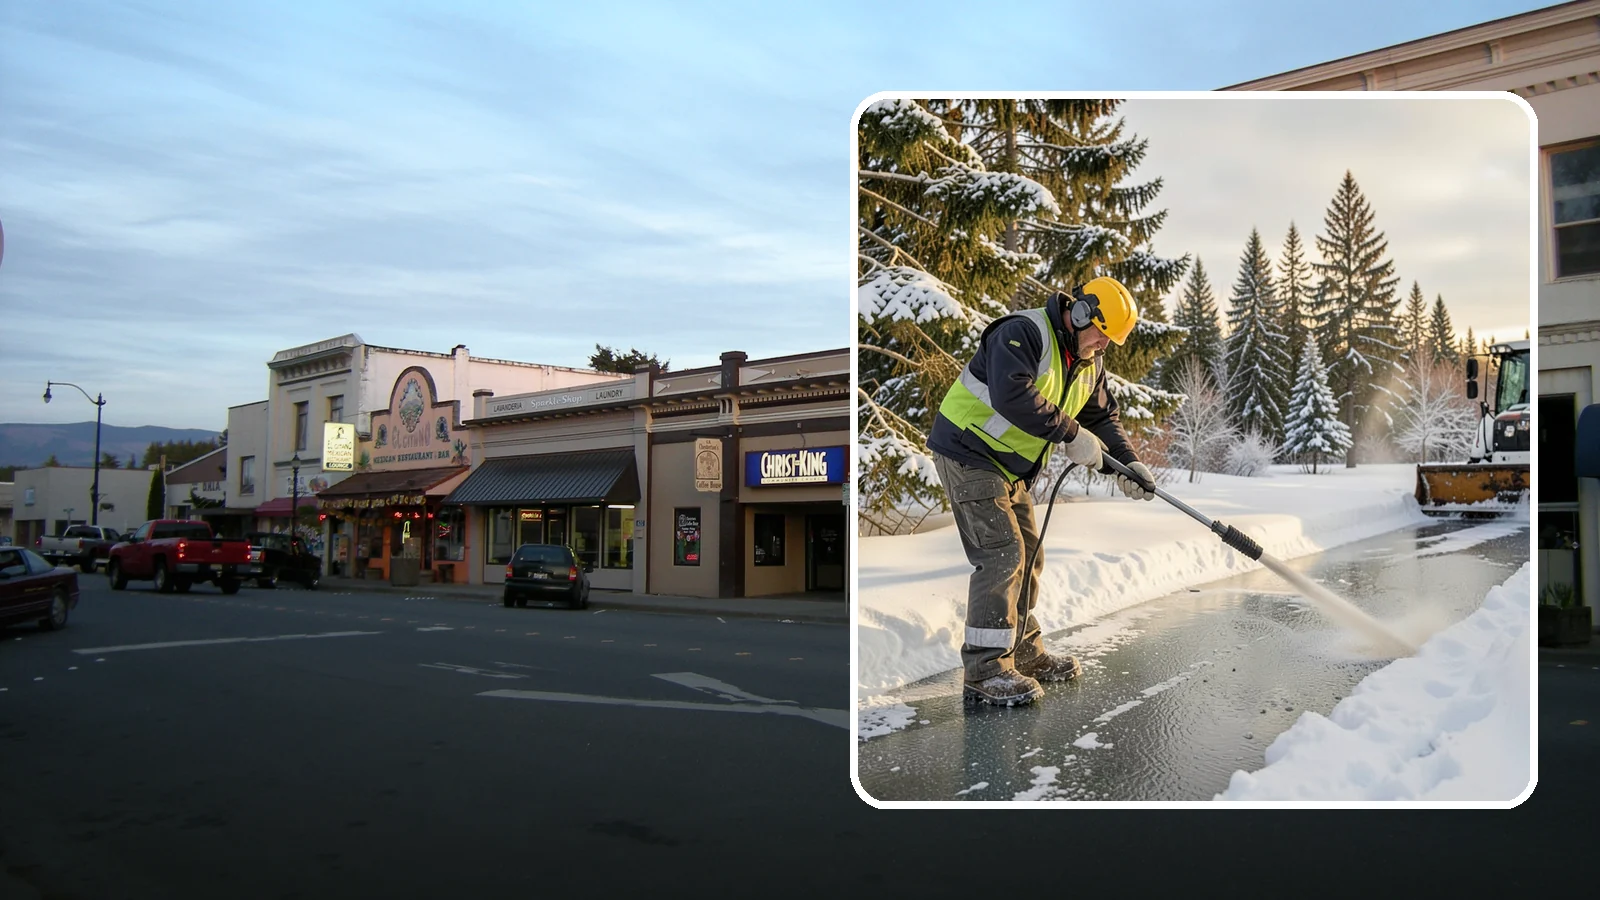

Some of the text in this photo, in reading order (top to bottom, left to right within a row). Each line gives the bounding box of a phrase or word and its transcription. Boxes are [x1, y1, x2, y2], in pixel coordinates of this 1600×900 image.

[493, 389, 623, 413] LAVANDERIA Sparkle Shop LAUNDRY
[373, 455, 396, 464] MEXICAN
[397, 451, 433, 462] RESTAURANT
[438, 450, 450, 459] BAR
[761, 452, 797, 478] CHRIST
[799, 450, 827, 476] KING
